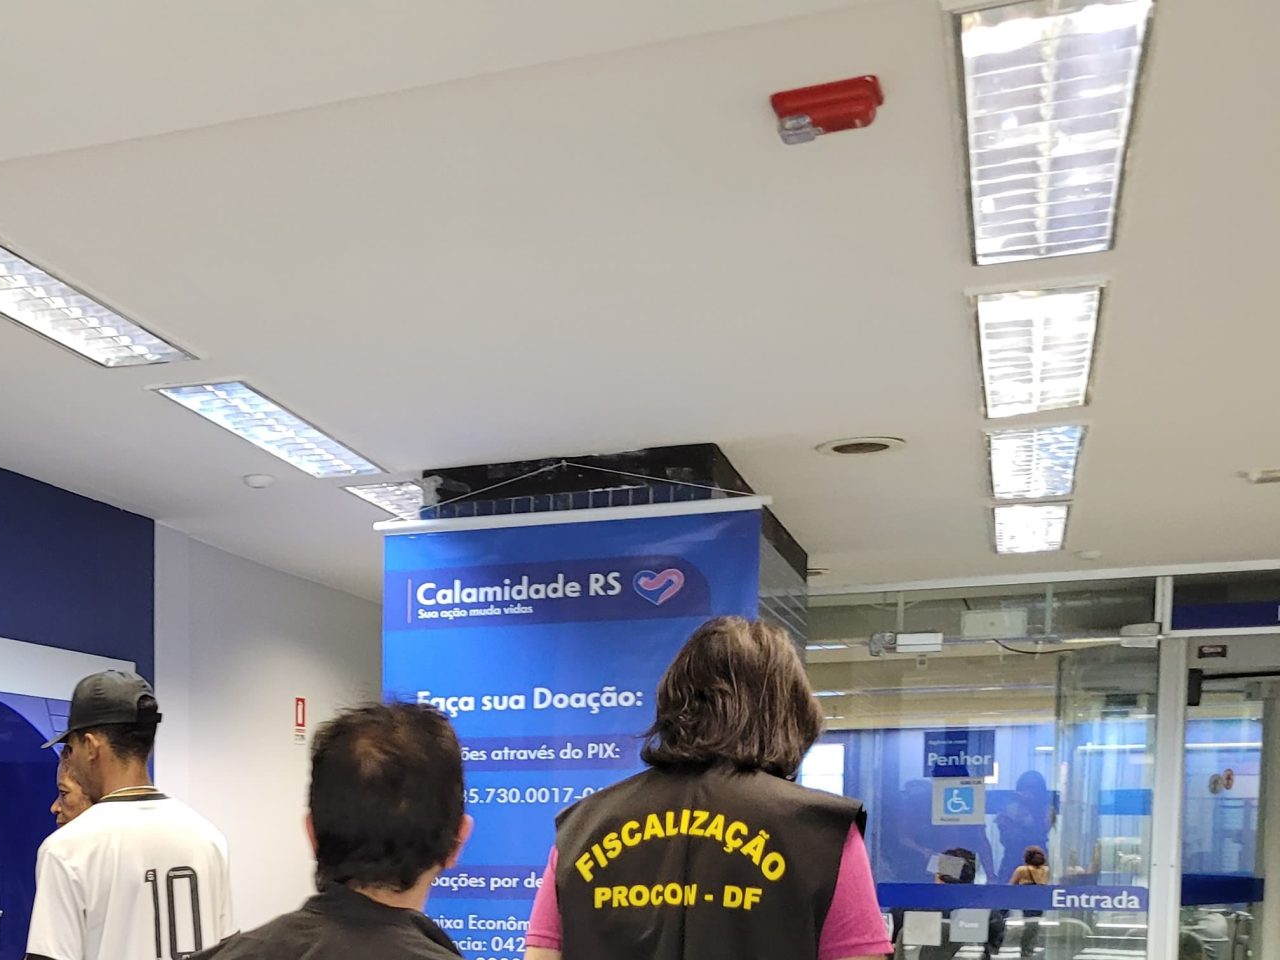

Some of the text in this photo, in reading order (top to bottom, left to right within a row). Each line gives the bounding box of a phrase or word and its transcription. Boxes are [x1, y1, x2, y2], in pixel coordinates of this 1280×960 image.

[416, 571, 622, 606] Calamidade RS
[417, 603, 534, 620] Sua ação muda vidas
[417, 686, 644, 718] Faça sua Doação:
[491, 744, 555, 761] através
[559, 742, 583, 760] do
[587, 742, 621, 759] PIX:
[927, 750, 992, 766] Penhor
[575, 808, 786, 883] FISCALIZAÇÃO
[490, 876, 519, 891] por
[594, 882, 763, 910] PROCON - DF
[1051, 889, 1141, 909] Entrada
[425, 913, 464, 930] aixa
